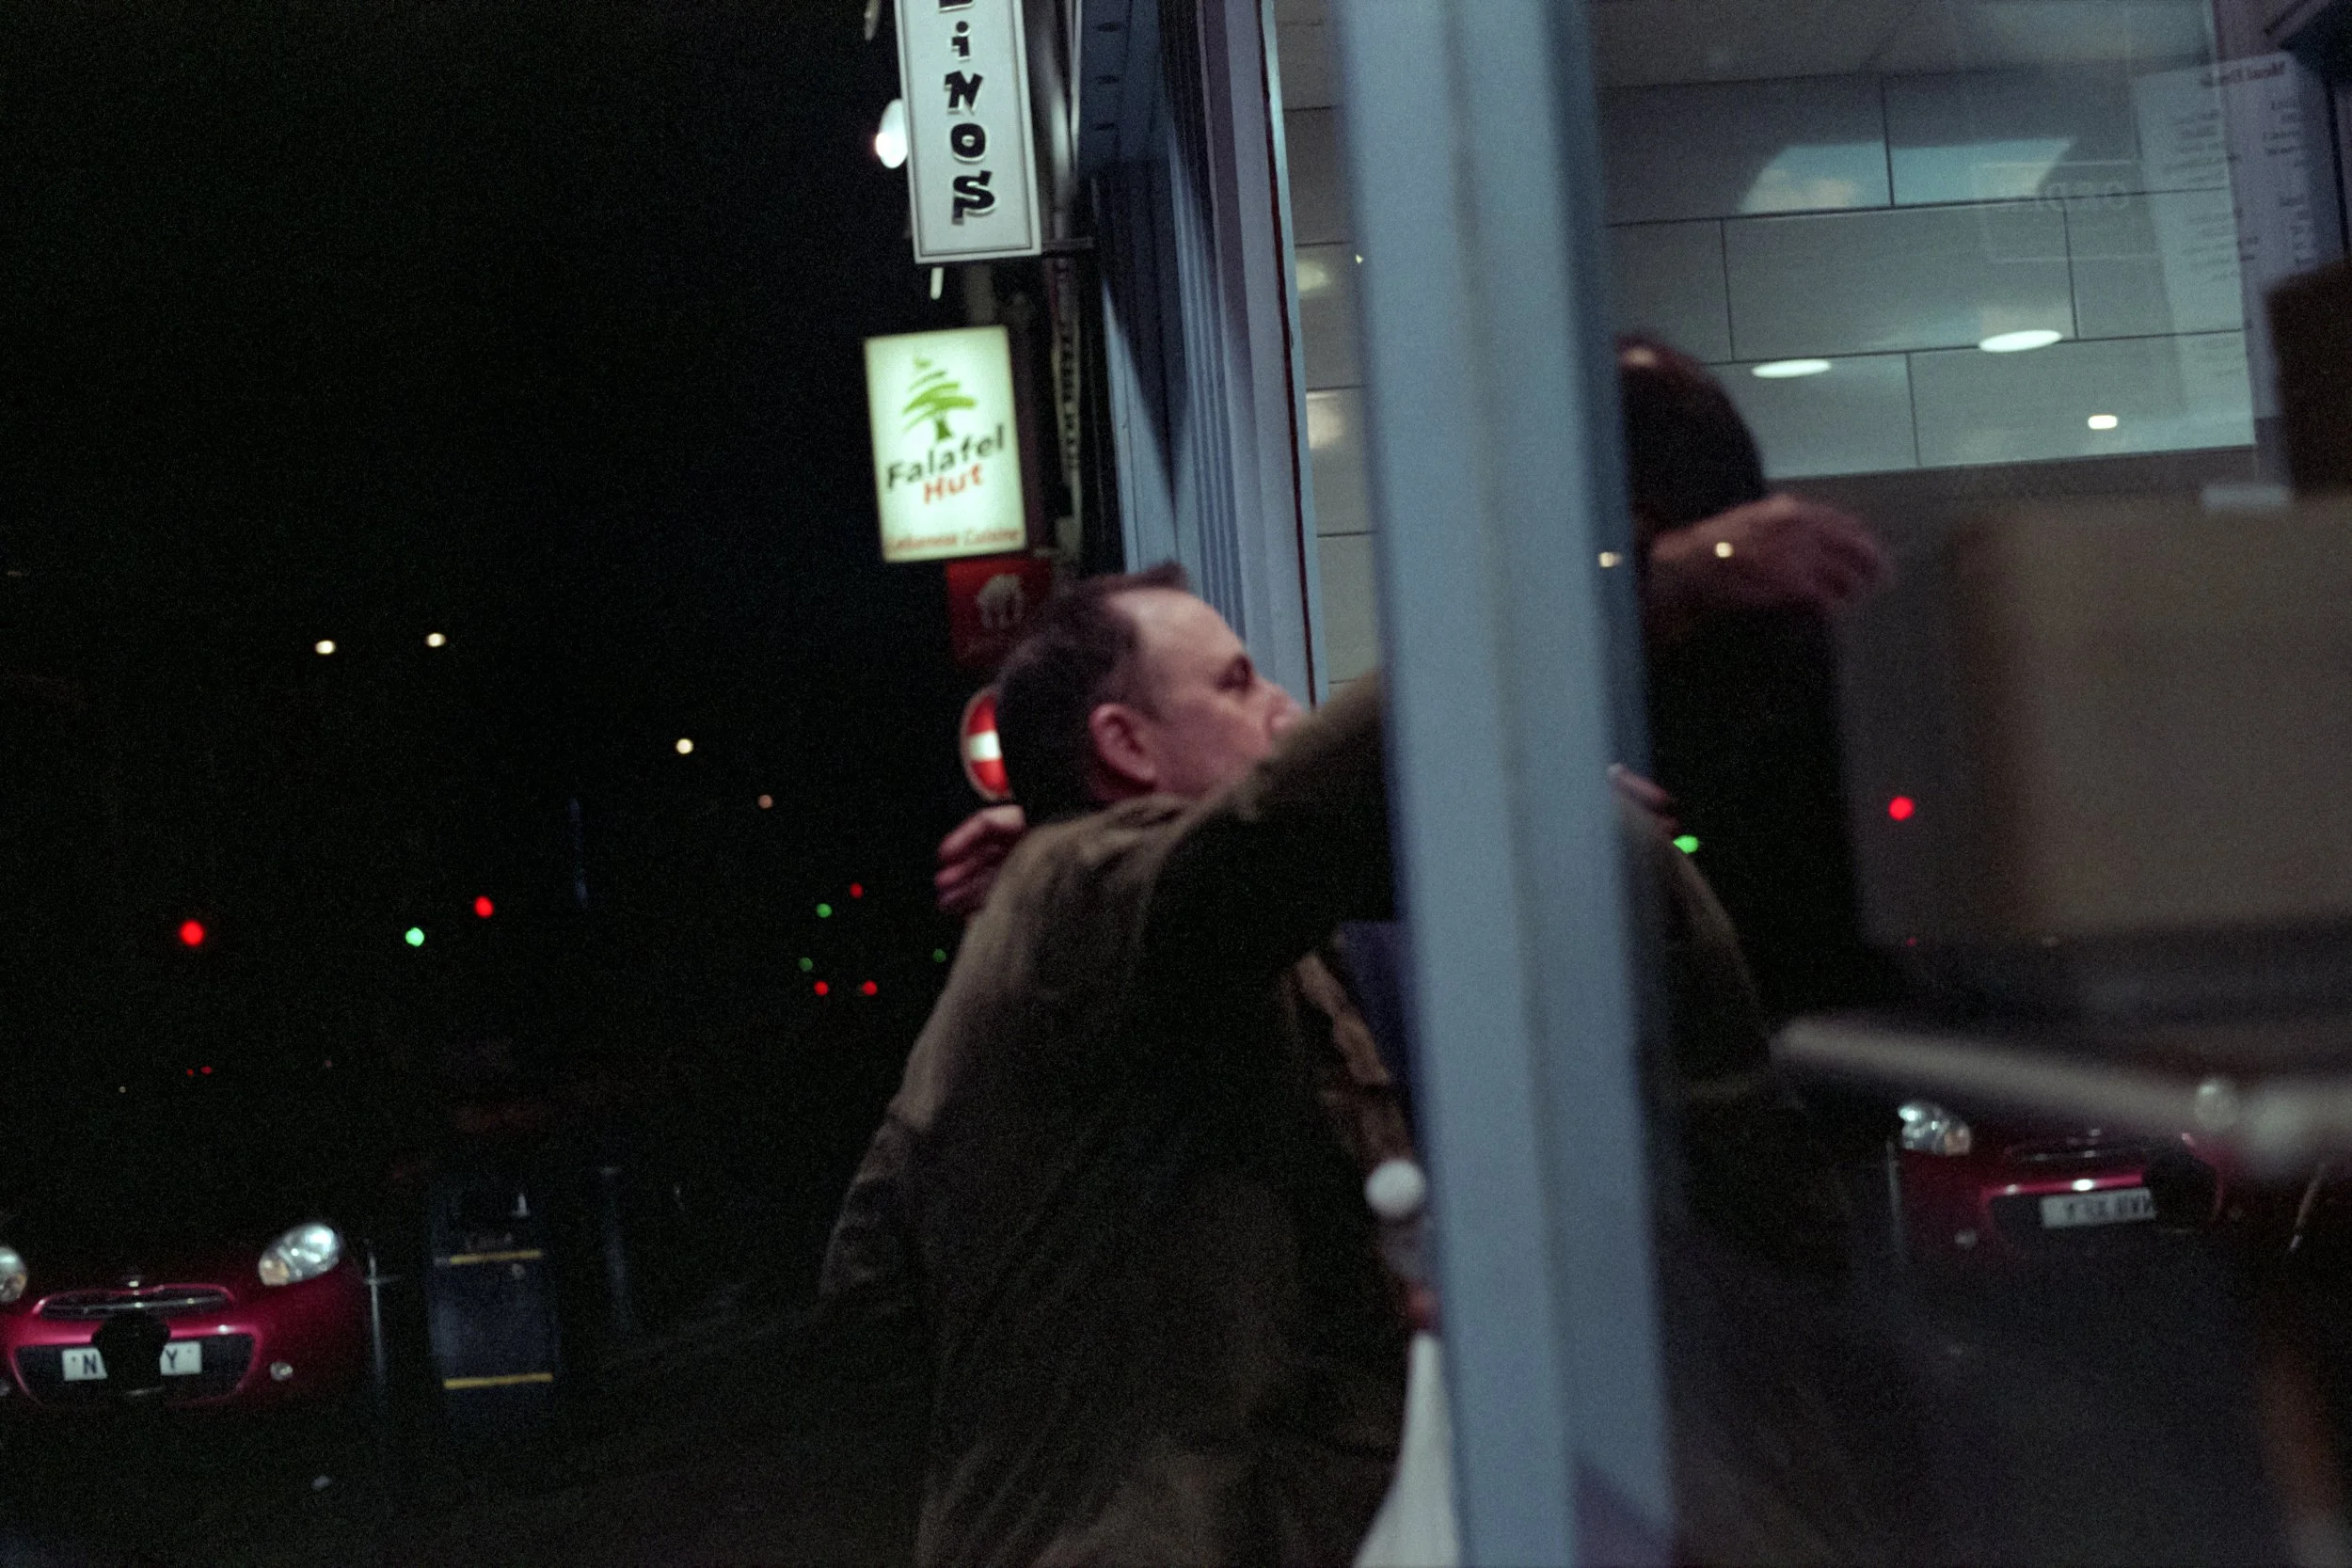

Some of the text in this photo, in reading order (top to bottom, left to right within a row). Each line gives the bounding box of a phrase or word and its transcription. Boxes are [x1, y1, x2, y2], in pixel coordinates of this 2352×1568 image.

[938, 0, 995, 225] iNOS
[886, 423, 1005, 489] Falafel
[924, 463, 983, 504] Hut
